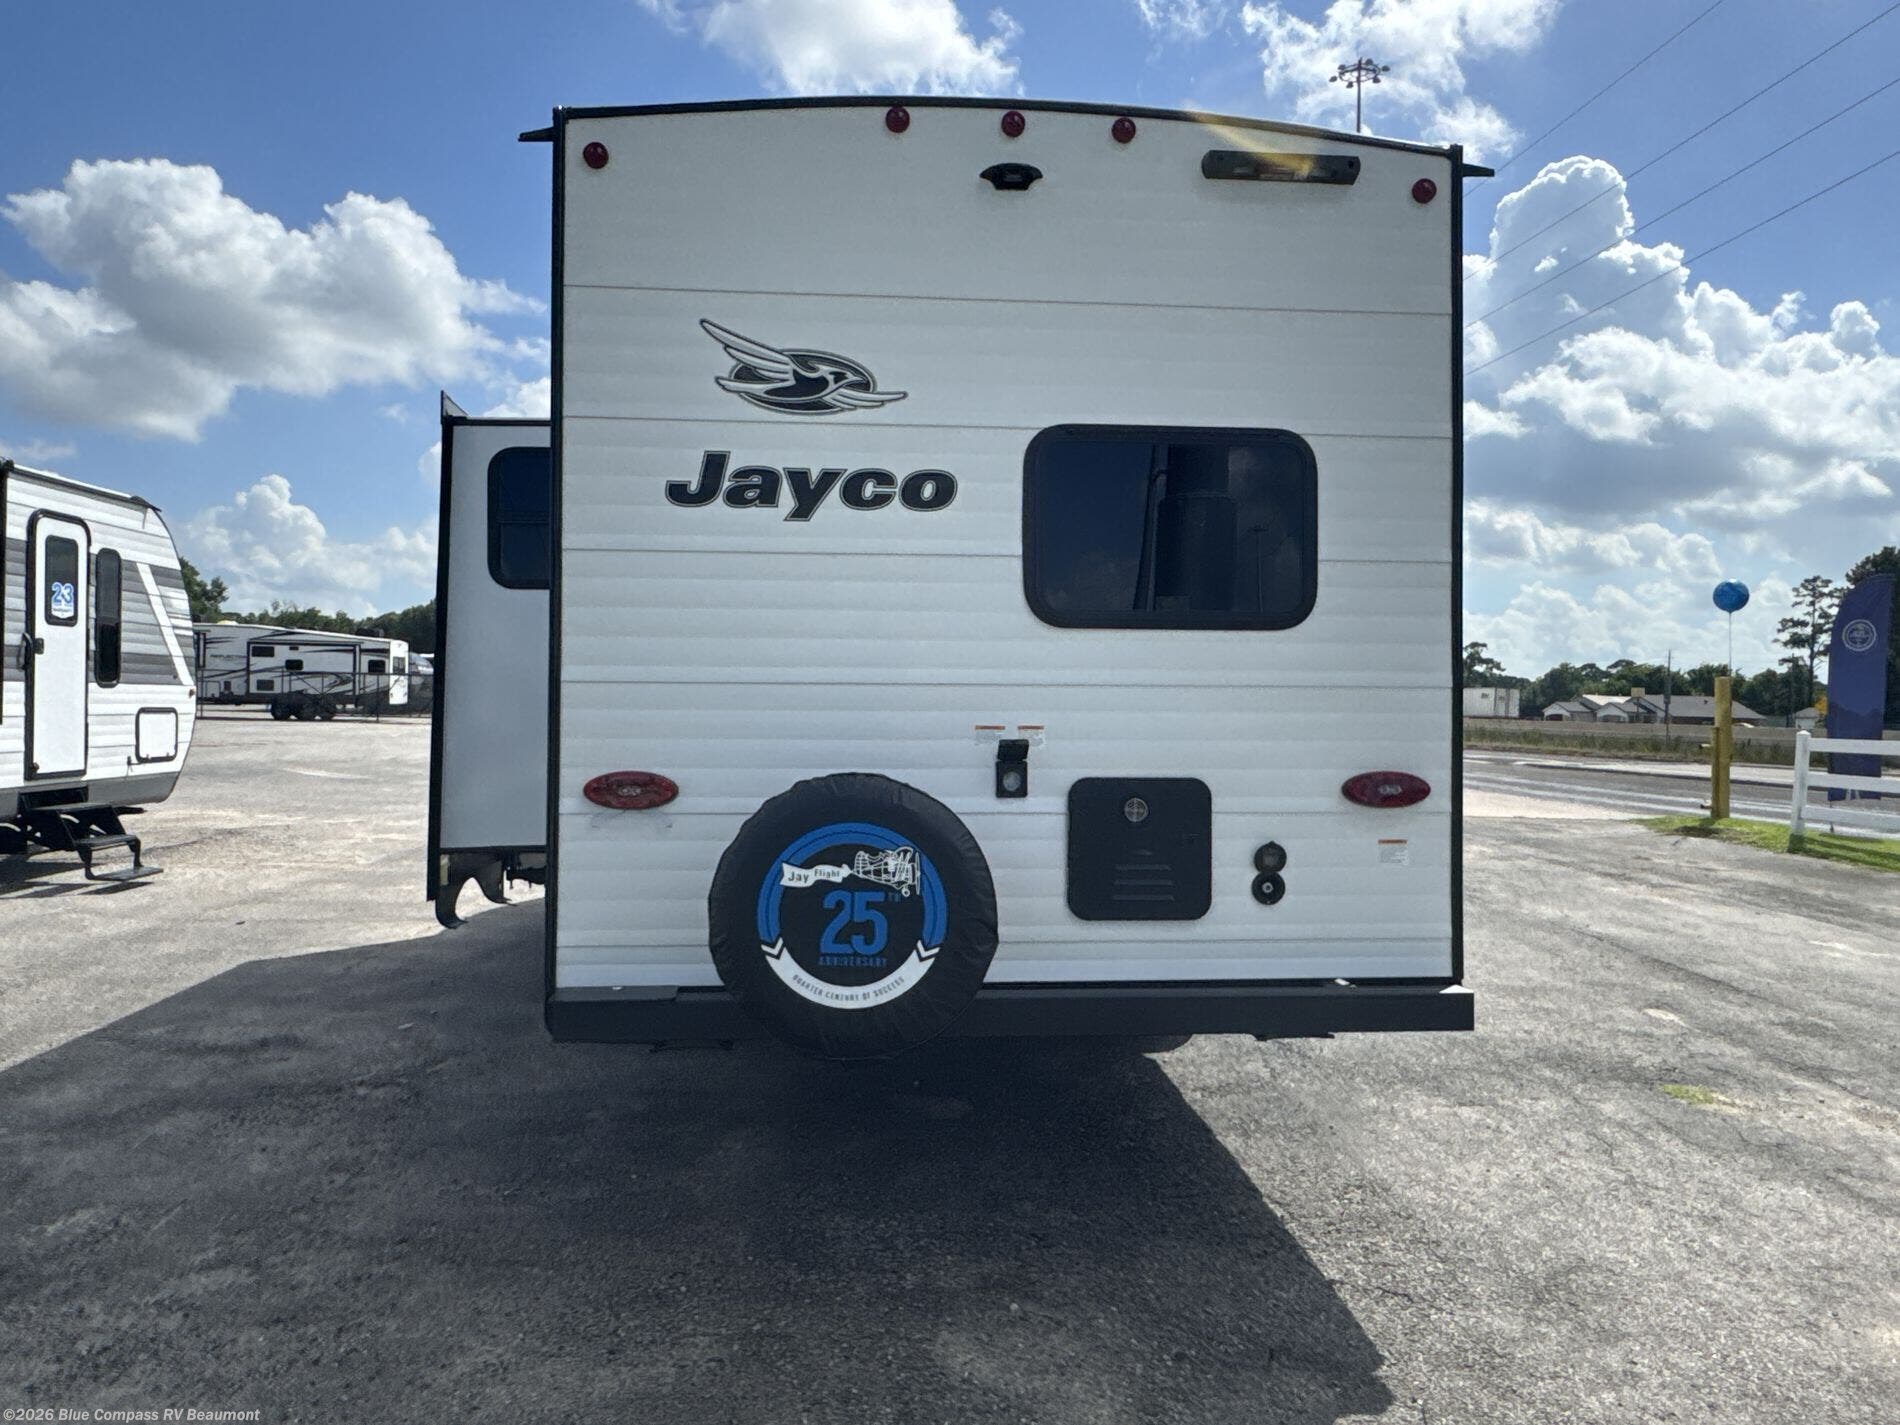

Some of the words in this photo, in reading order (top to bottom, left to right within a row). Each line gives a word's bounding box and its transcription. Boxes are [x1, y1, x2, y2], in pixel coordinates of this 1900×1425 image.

[665, 450, 958, 521] Jayco
[52, 582, 74, 603] 23
[788, 871, 809, 883] Jay
[814, 868, 840, 879] Flight
[873, 976, 905, 997] SUCCESS
